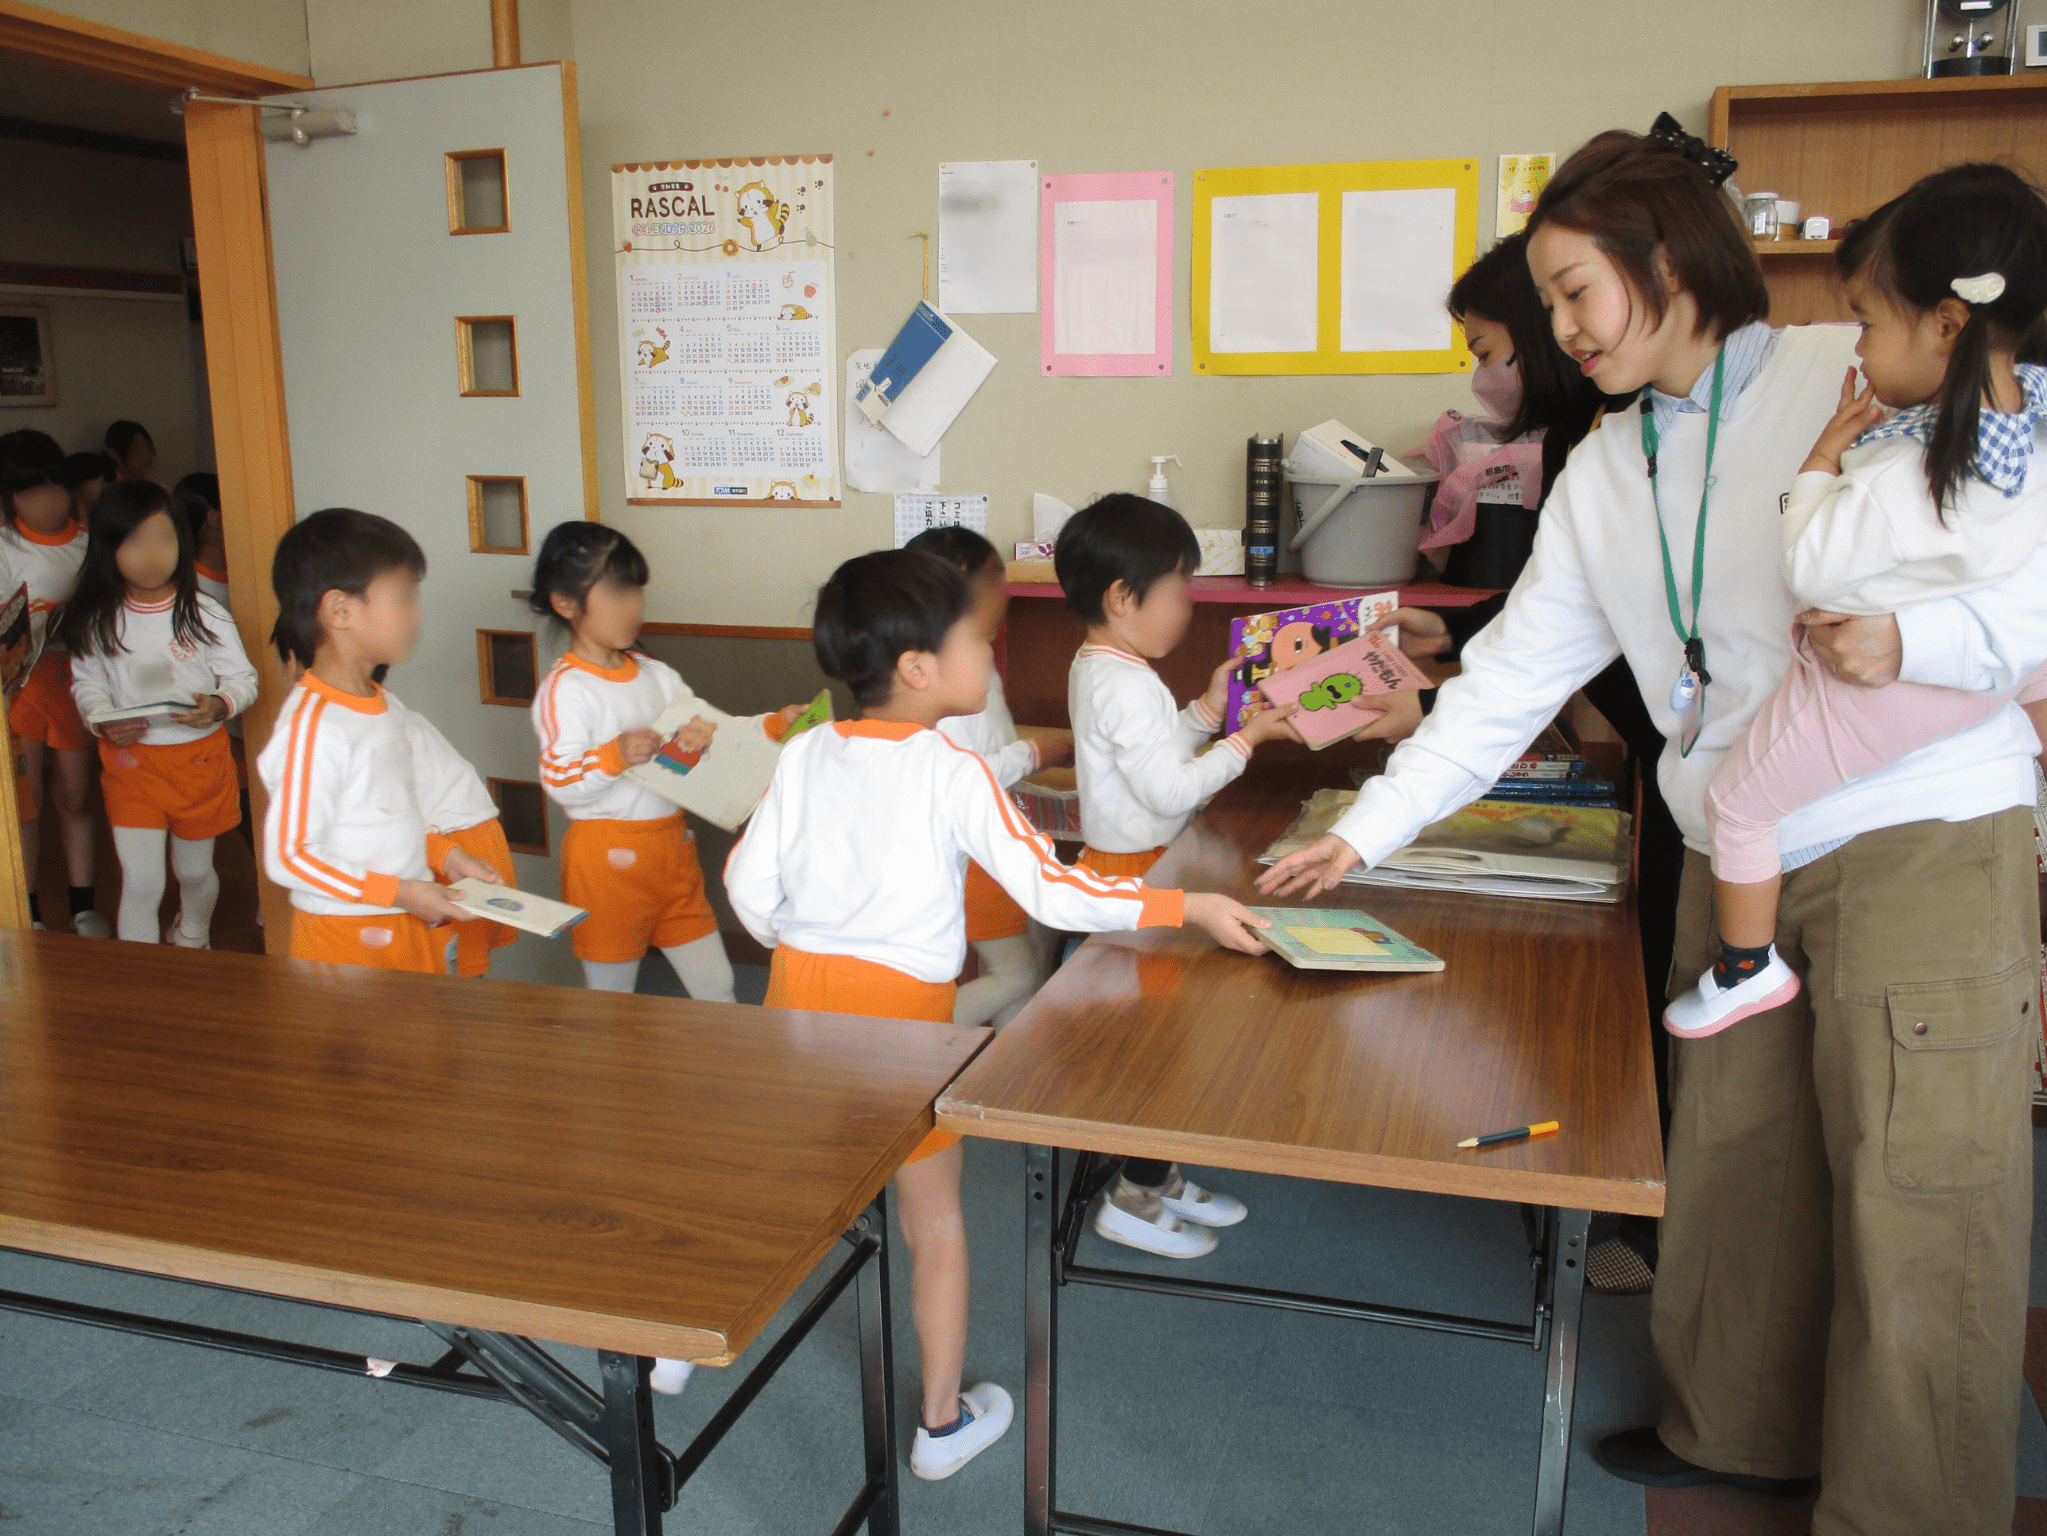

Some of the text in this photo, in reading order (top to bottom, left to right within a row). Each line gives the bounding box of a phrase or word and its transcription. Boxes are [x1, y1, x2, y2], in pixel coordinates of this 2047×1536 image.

[631, 195, 715, 218] RASCAL
[632, 221, 716, 236] CALENDAR 2026
